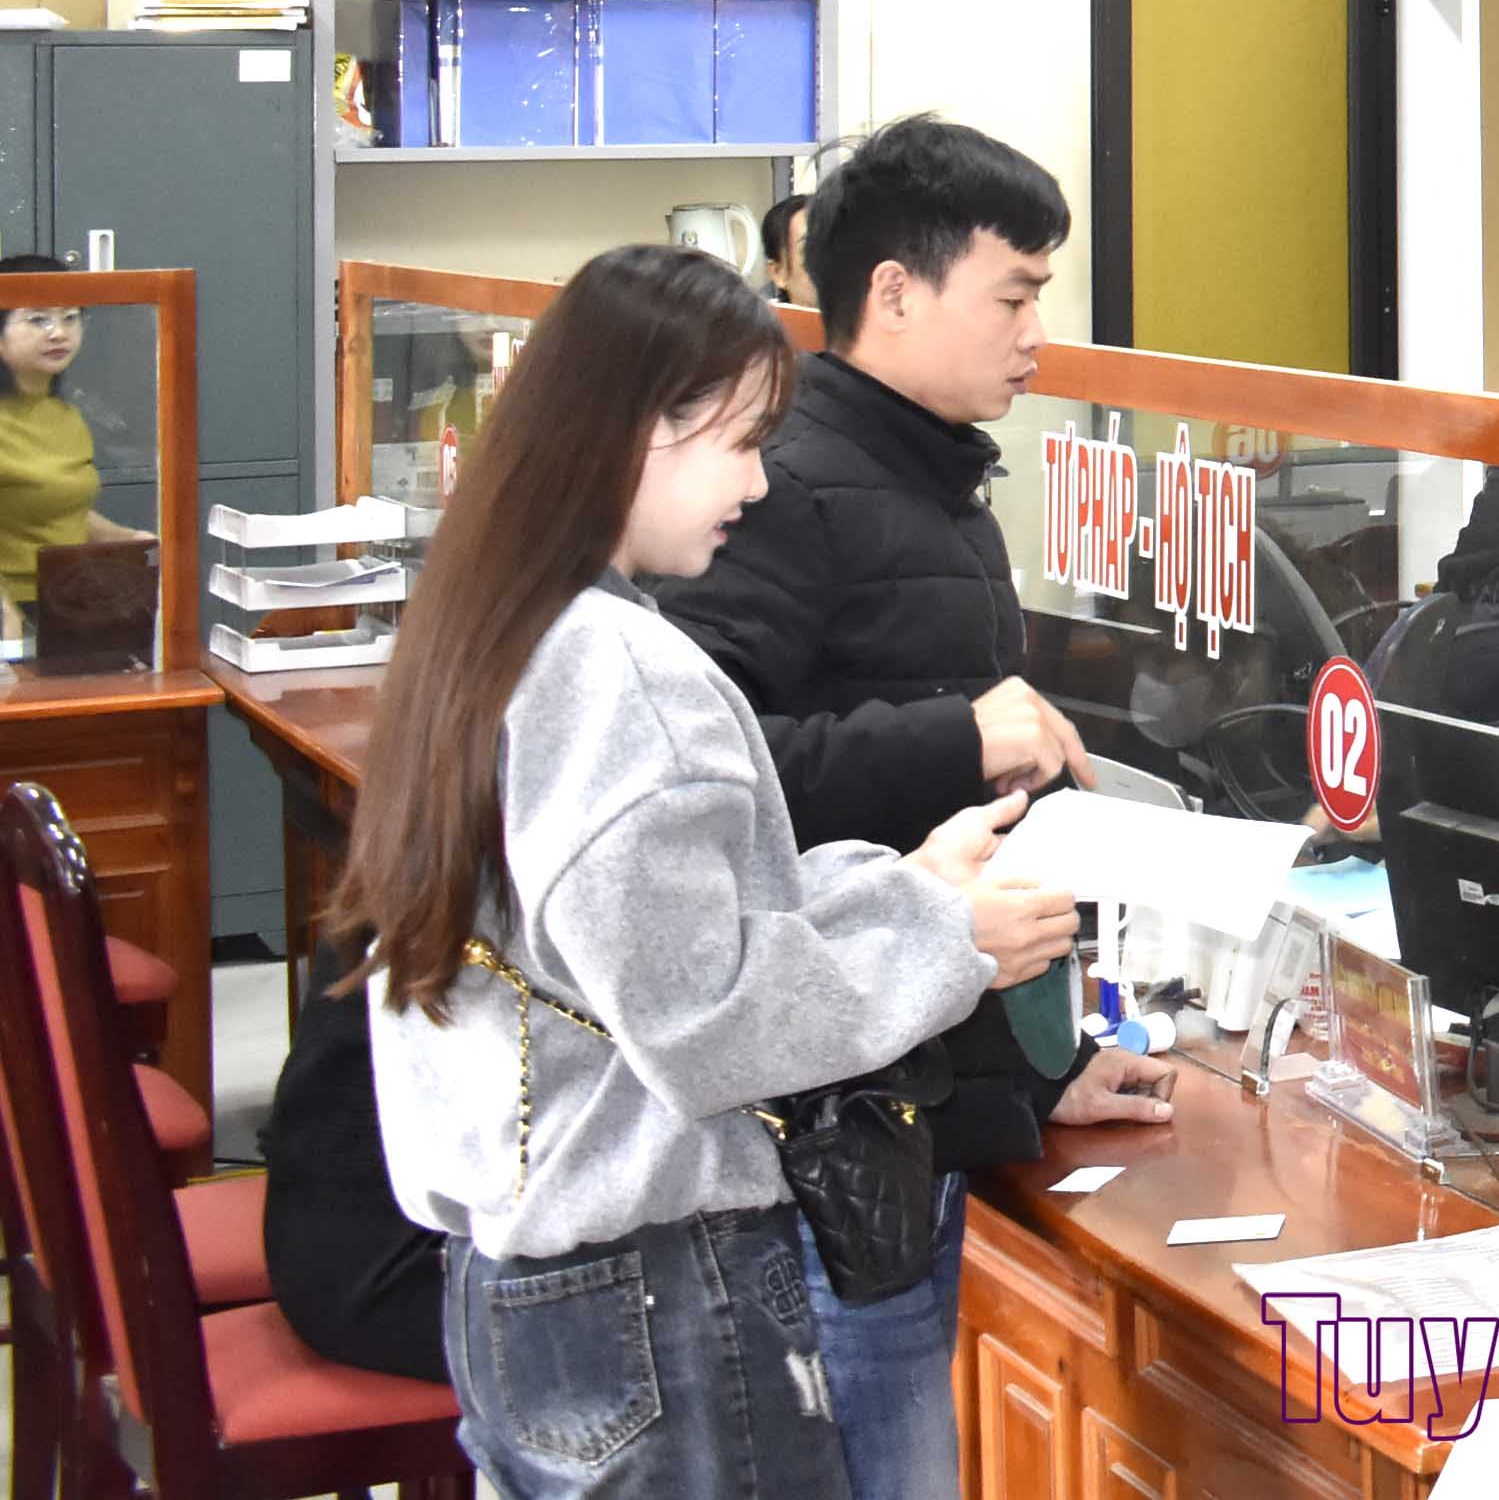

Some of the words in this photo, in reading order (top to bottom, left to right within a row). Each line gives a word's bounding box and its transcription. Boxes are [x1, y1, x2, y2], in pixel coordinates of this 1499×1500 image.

[1041, 419, 1076, 585] TƯ
[1072, 411, 1139, 601] PHÁP
[1155, 421, 1193, 652] HỘ
[1195, 458, 1257, 661] TỊCH
[1321, 691, 1368, 797] 02
